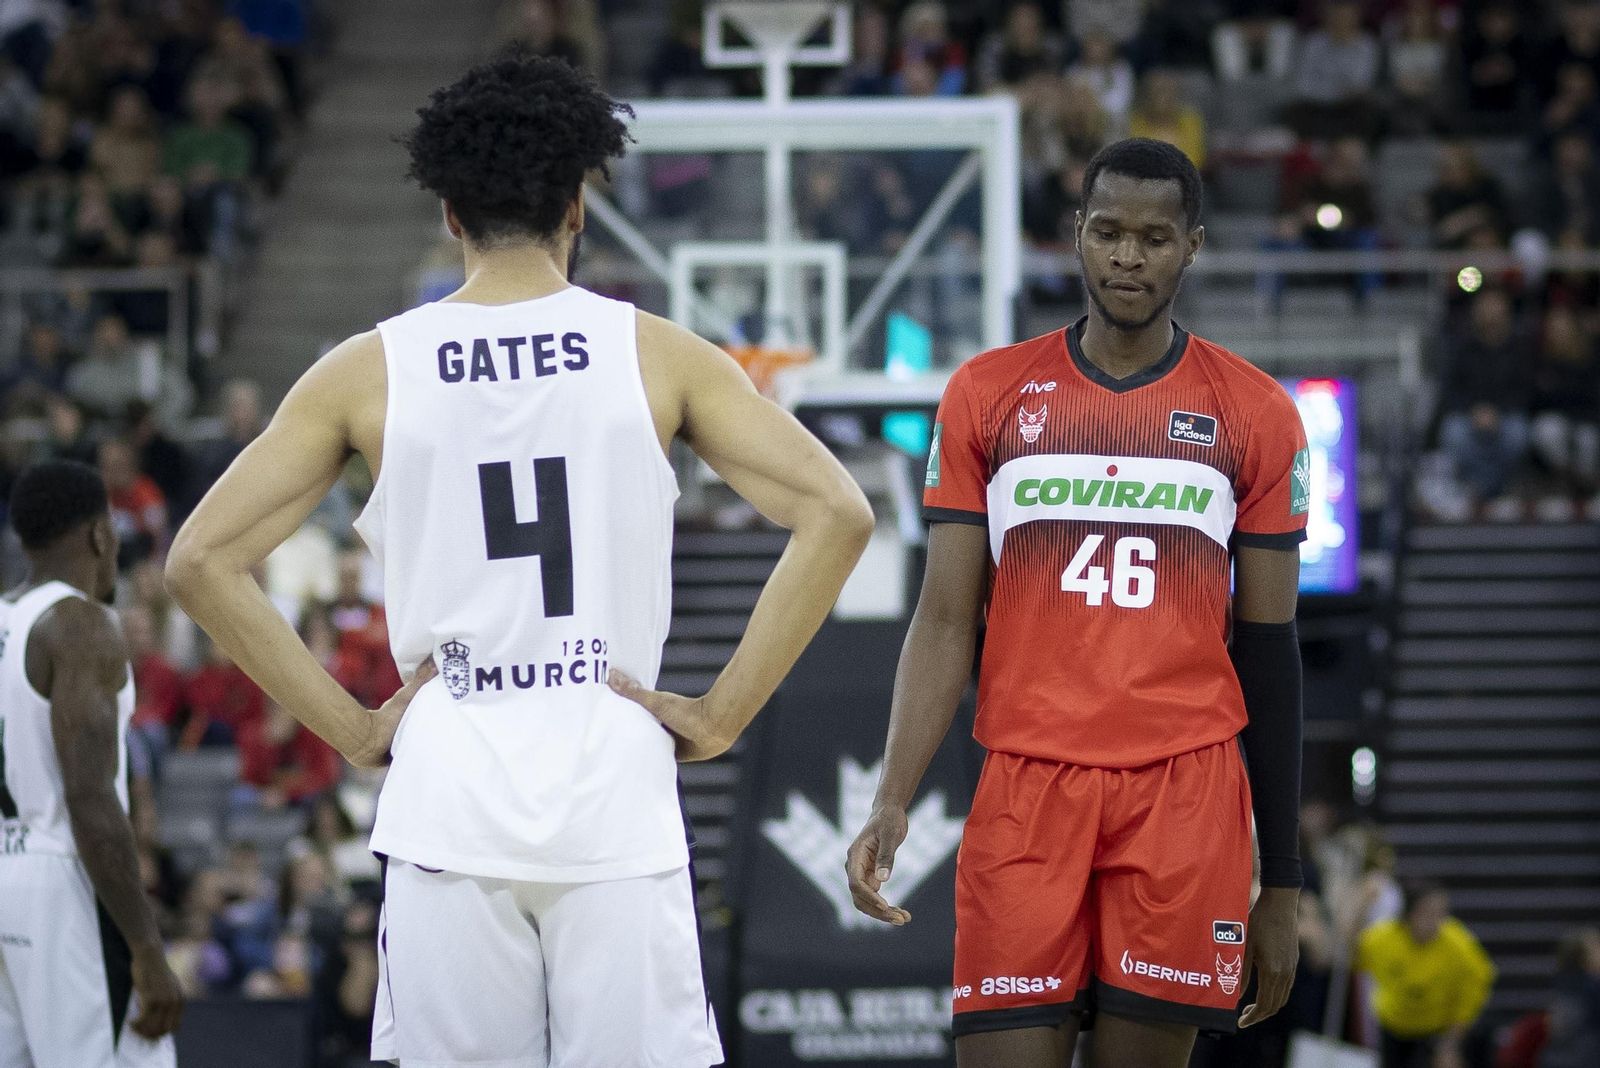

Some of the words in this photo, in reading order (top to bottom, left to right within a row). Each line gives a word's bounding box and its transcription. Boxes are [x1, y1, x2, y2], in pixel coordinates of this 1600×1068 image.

[438, 332, 590, 383] GATES
[1174, 429, 1212, 442] endesa
[1175, 420, 1192, 430] liga
[1014, 466, 1213, 514] COVIRAN
[478, 456, 574, 618] 4
[1060, 535, 1157, 609] 46
[1217, 930, 1236, 941] acb
[1136, 962, 1211, 987] BERNER
[952, 985, 972, 1000] ive
[980, 976, 1045, 996] asisa
